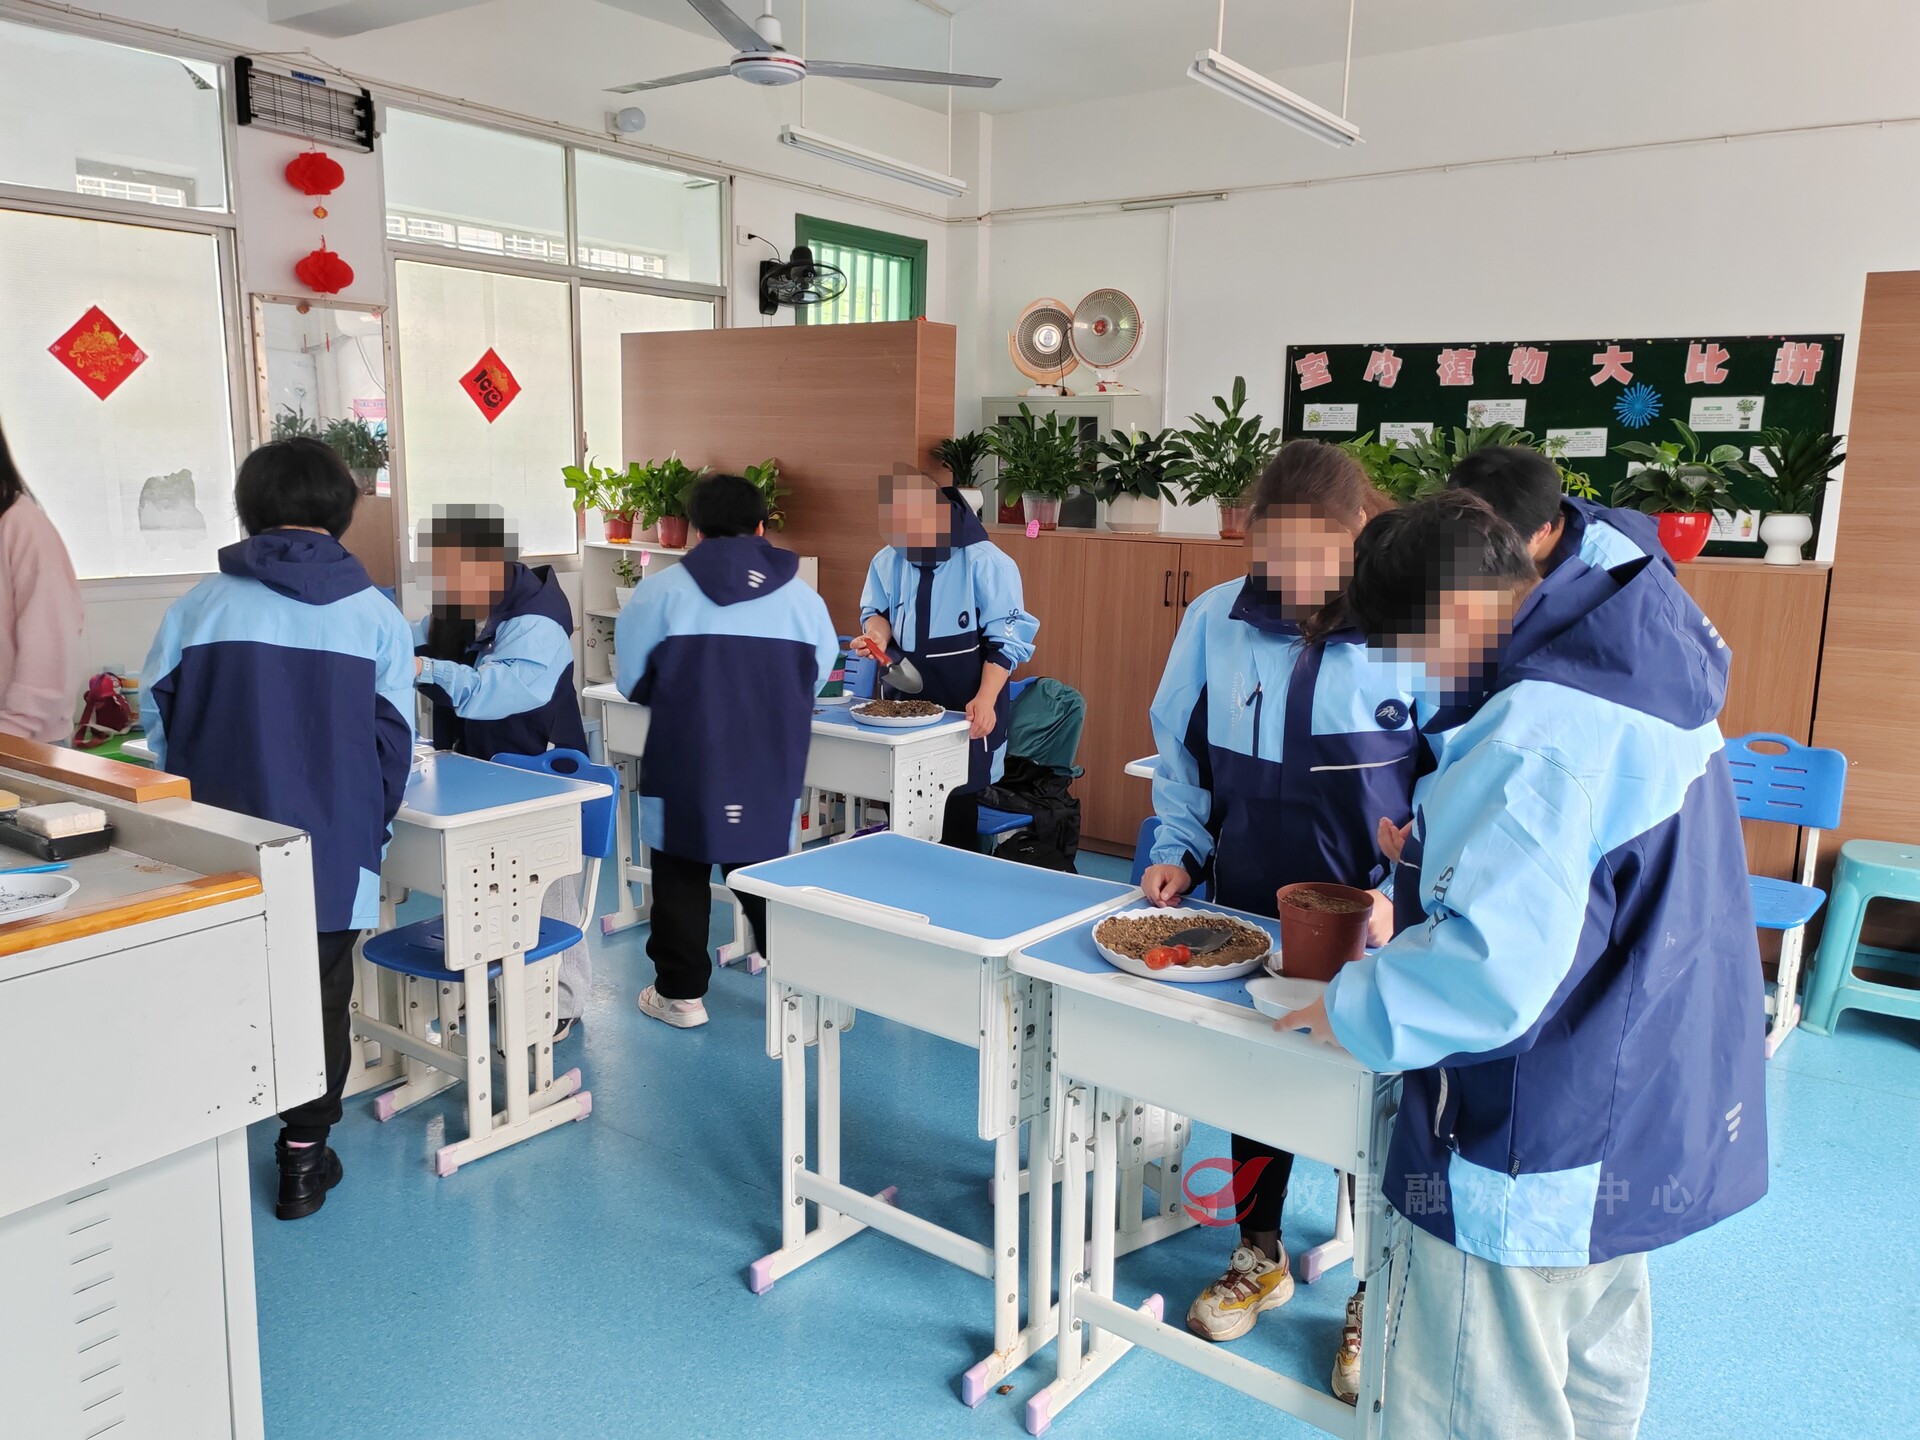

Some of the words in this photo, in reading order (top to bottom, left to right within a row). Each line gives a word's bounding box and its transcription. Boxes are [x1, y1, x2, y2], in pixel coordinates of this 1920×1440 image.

[1295, 341, 1824, 391] 室内植物大比拼
